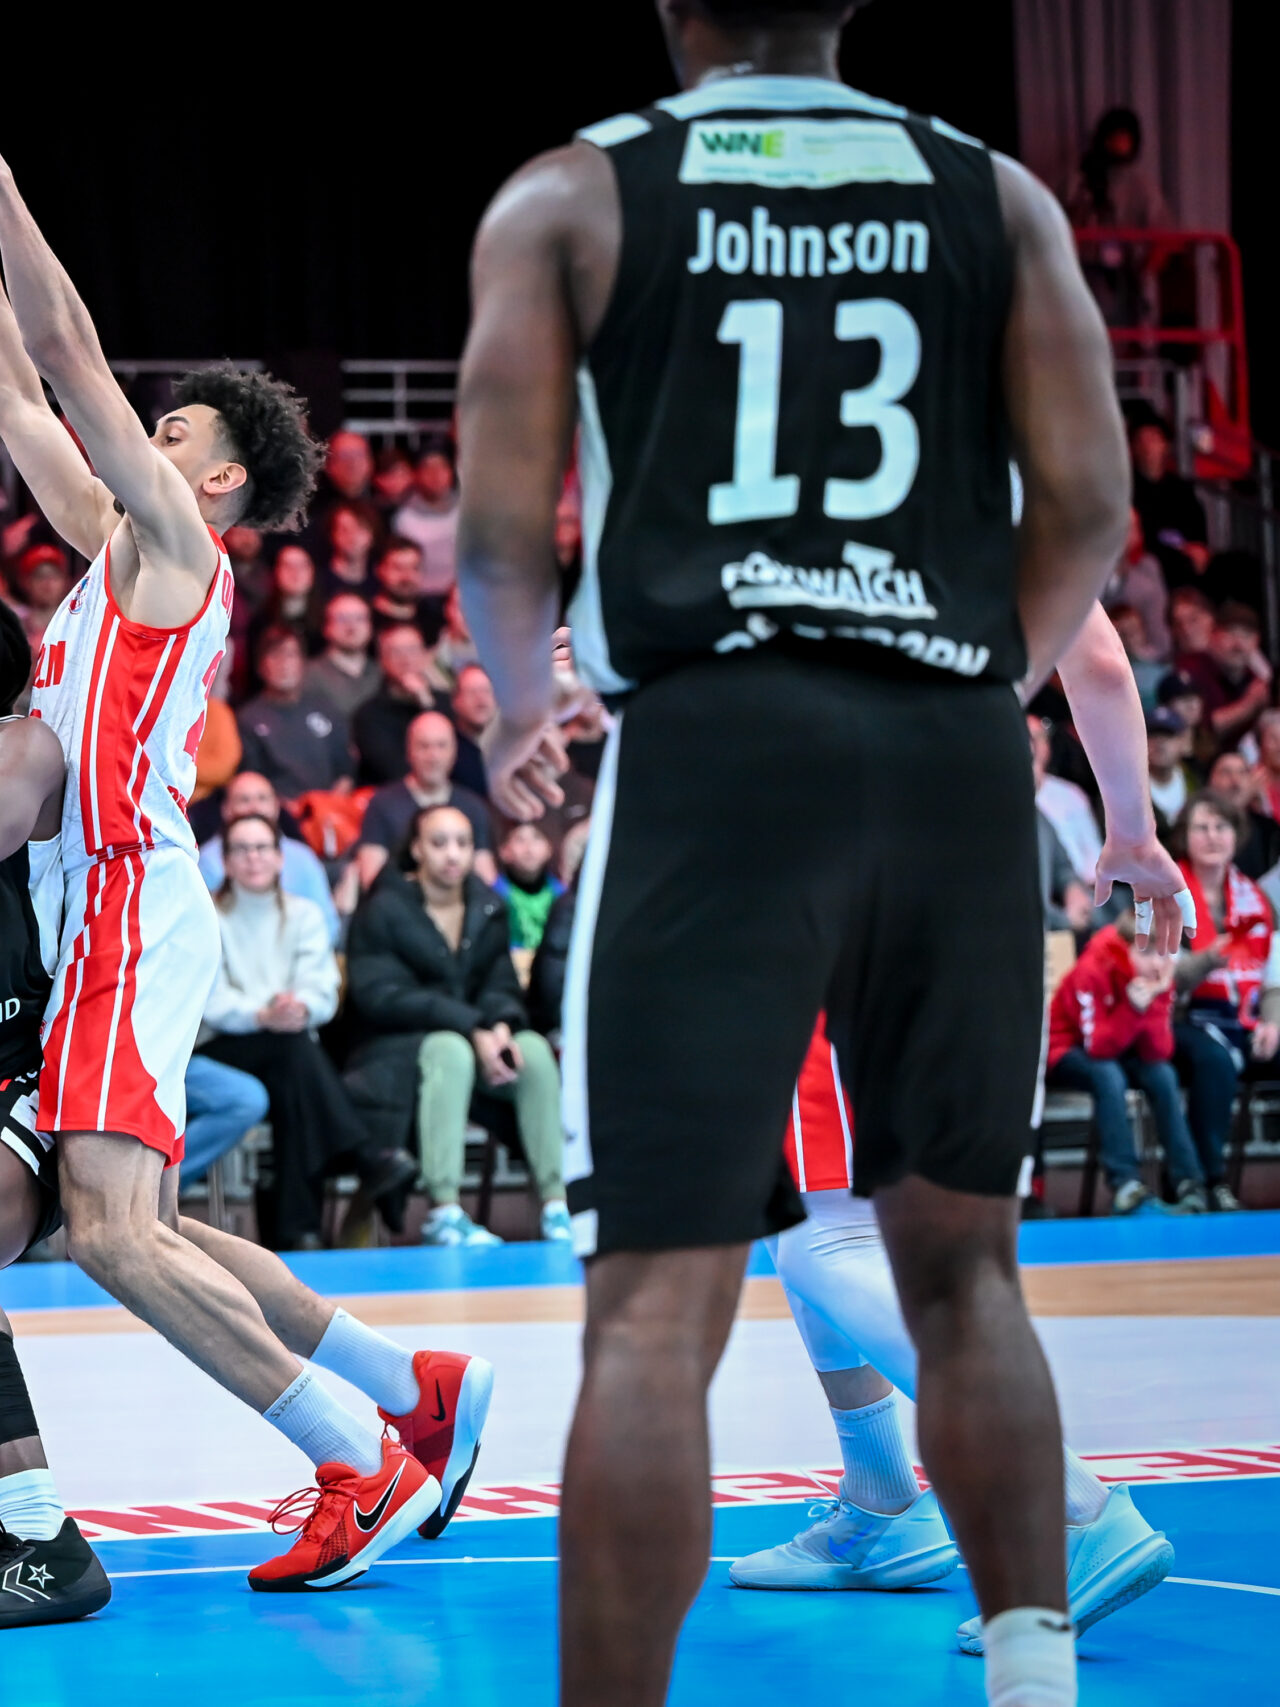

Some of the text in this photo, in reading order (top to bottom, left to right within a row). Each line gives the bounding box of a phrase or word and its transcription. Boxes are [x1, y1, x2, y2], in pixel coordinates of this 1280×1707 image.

[699, 130, 785, 158] WNE
[688, 207, 930, 276] Johnson
[707, 298, 921, 526] 13
